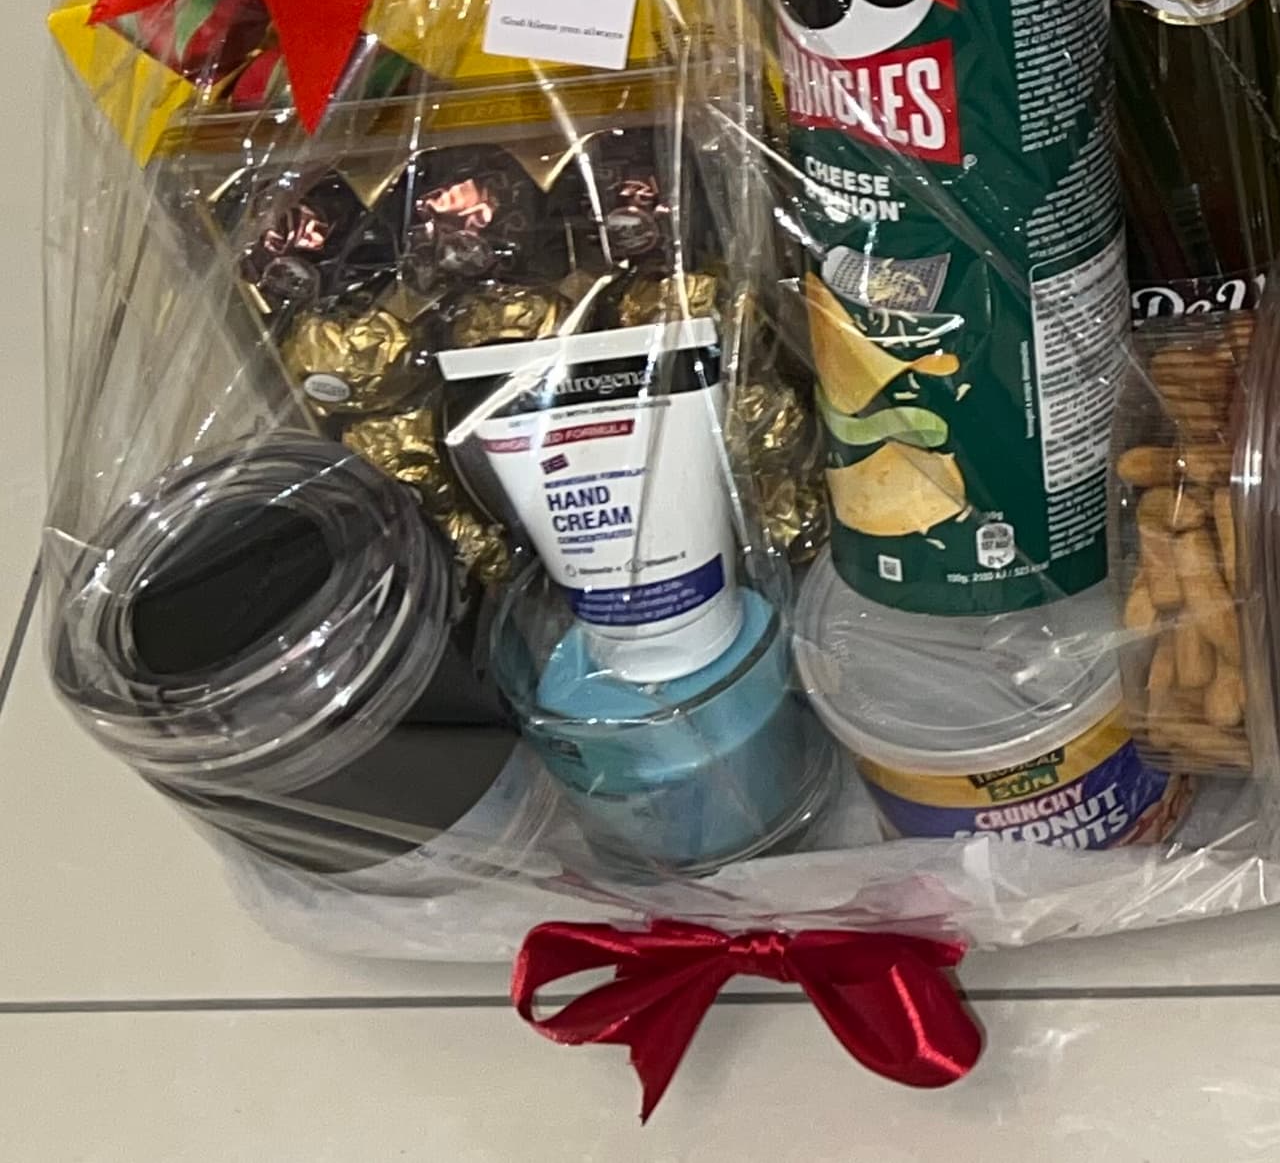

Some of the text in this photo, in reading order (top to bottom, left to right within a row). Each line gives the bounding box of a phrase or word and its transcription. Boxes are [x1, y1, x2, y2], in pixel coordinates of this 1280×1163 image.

[780, 37, 947, 150] RINGLES
[804, 155, 891, 197] CHEESE
[519, 369, 652, 398] Ntrogena
[546, 485, 611, 512] HAND
[551, 505, 633, 533] CREAM
[990, 775, 1055, 798] SUN
[954, 781, 1118, 844] CONUT
[975, 781, 1084, 830] CRUNCHY
